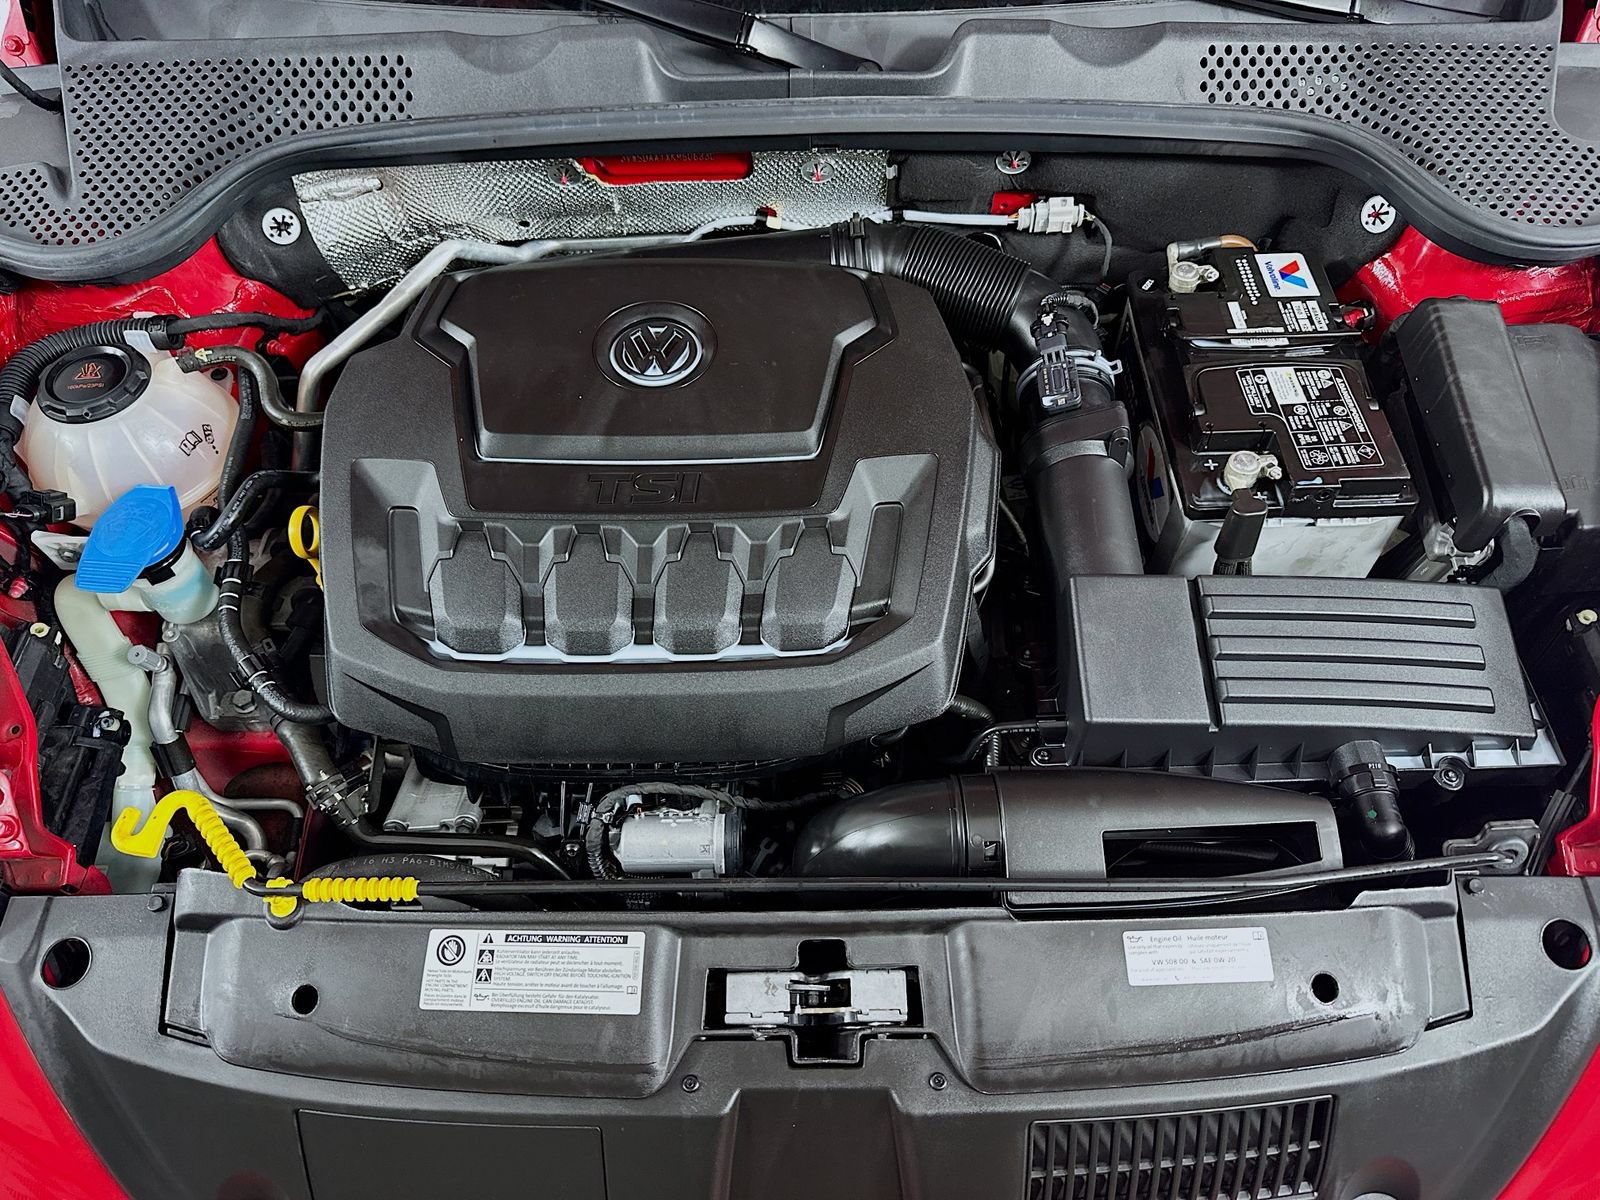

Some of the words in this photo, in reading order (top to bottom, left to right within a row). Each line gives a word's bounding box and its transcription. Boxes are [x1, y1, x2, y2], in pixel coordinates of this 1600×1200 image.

[1265, 261, 1281, 291] Valvoline
[588, 472, 702, 504] TSI
[507, 934, 542, 942] ACHTUNG
[1150, 935, 1171, 943] Engine
